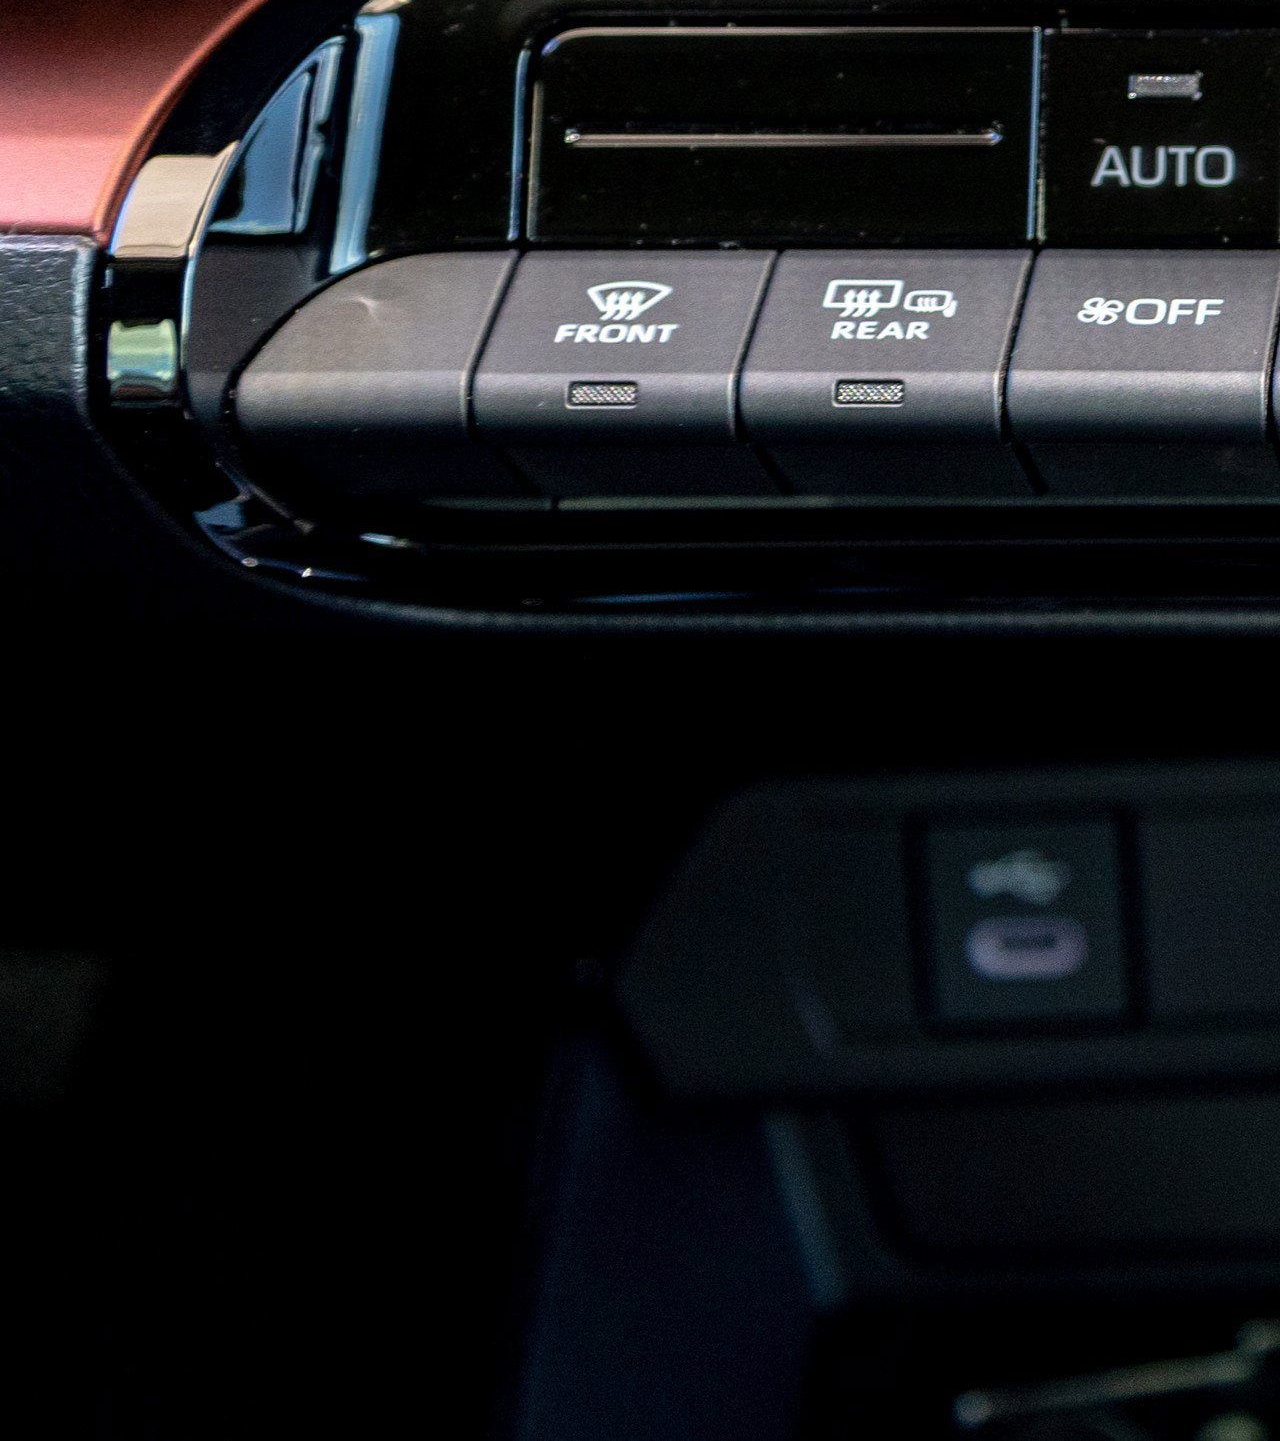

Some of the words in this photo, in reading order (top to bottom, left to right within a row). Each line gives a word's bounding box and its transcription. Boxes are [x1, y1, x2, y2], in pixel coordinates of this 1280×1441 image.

[1091, 144, 1235, 187] AUTO
[1125, 298, 1225, 326] OFF
[553, 323, 680, 344] FRONT
[830, 320, 931, 341] REAR
